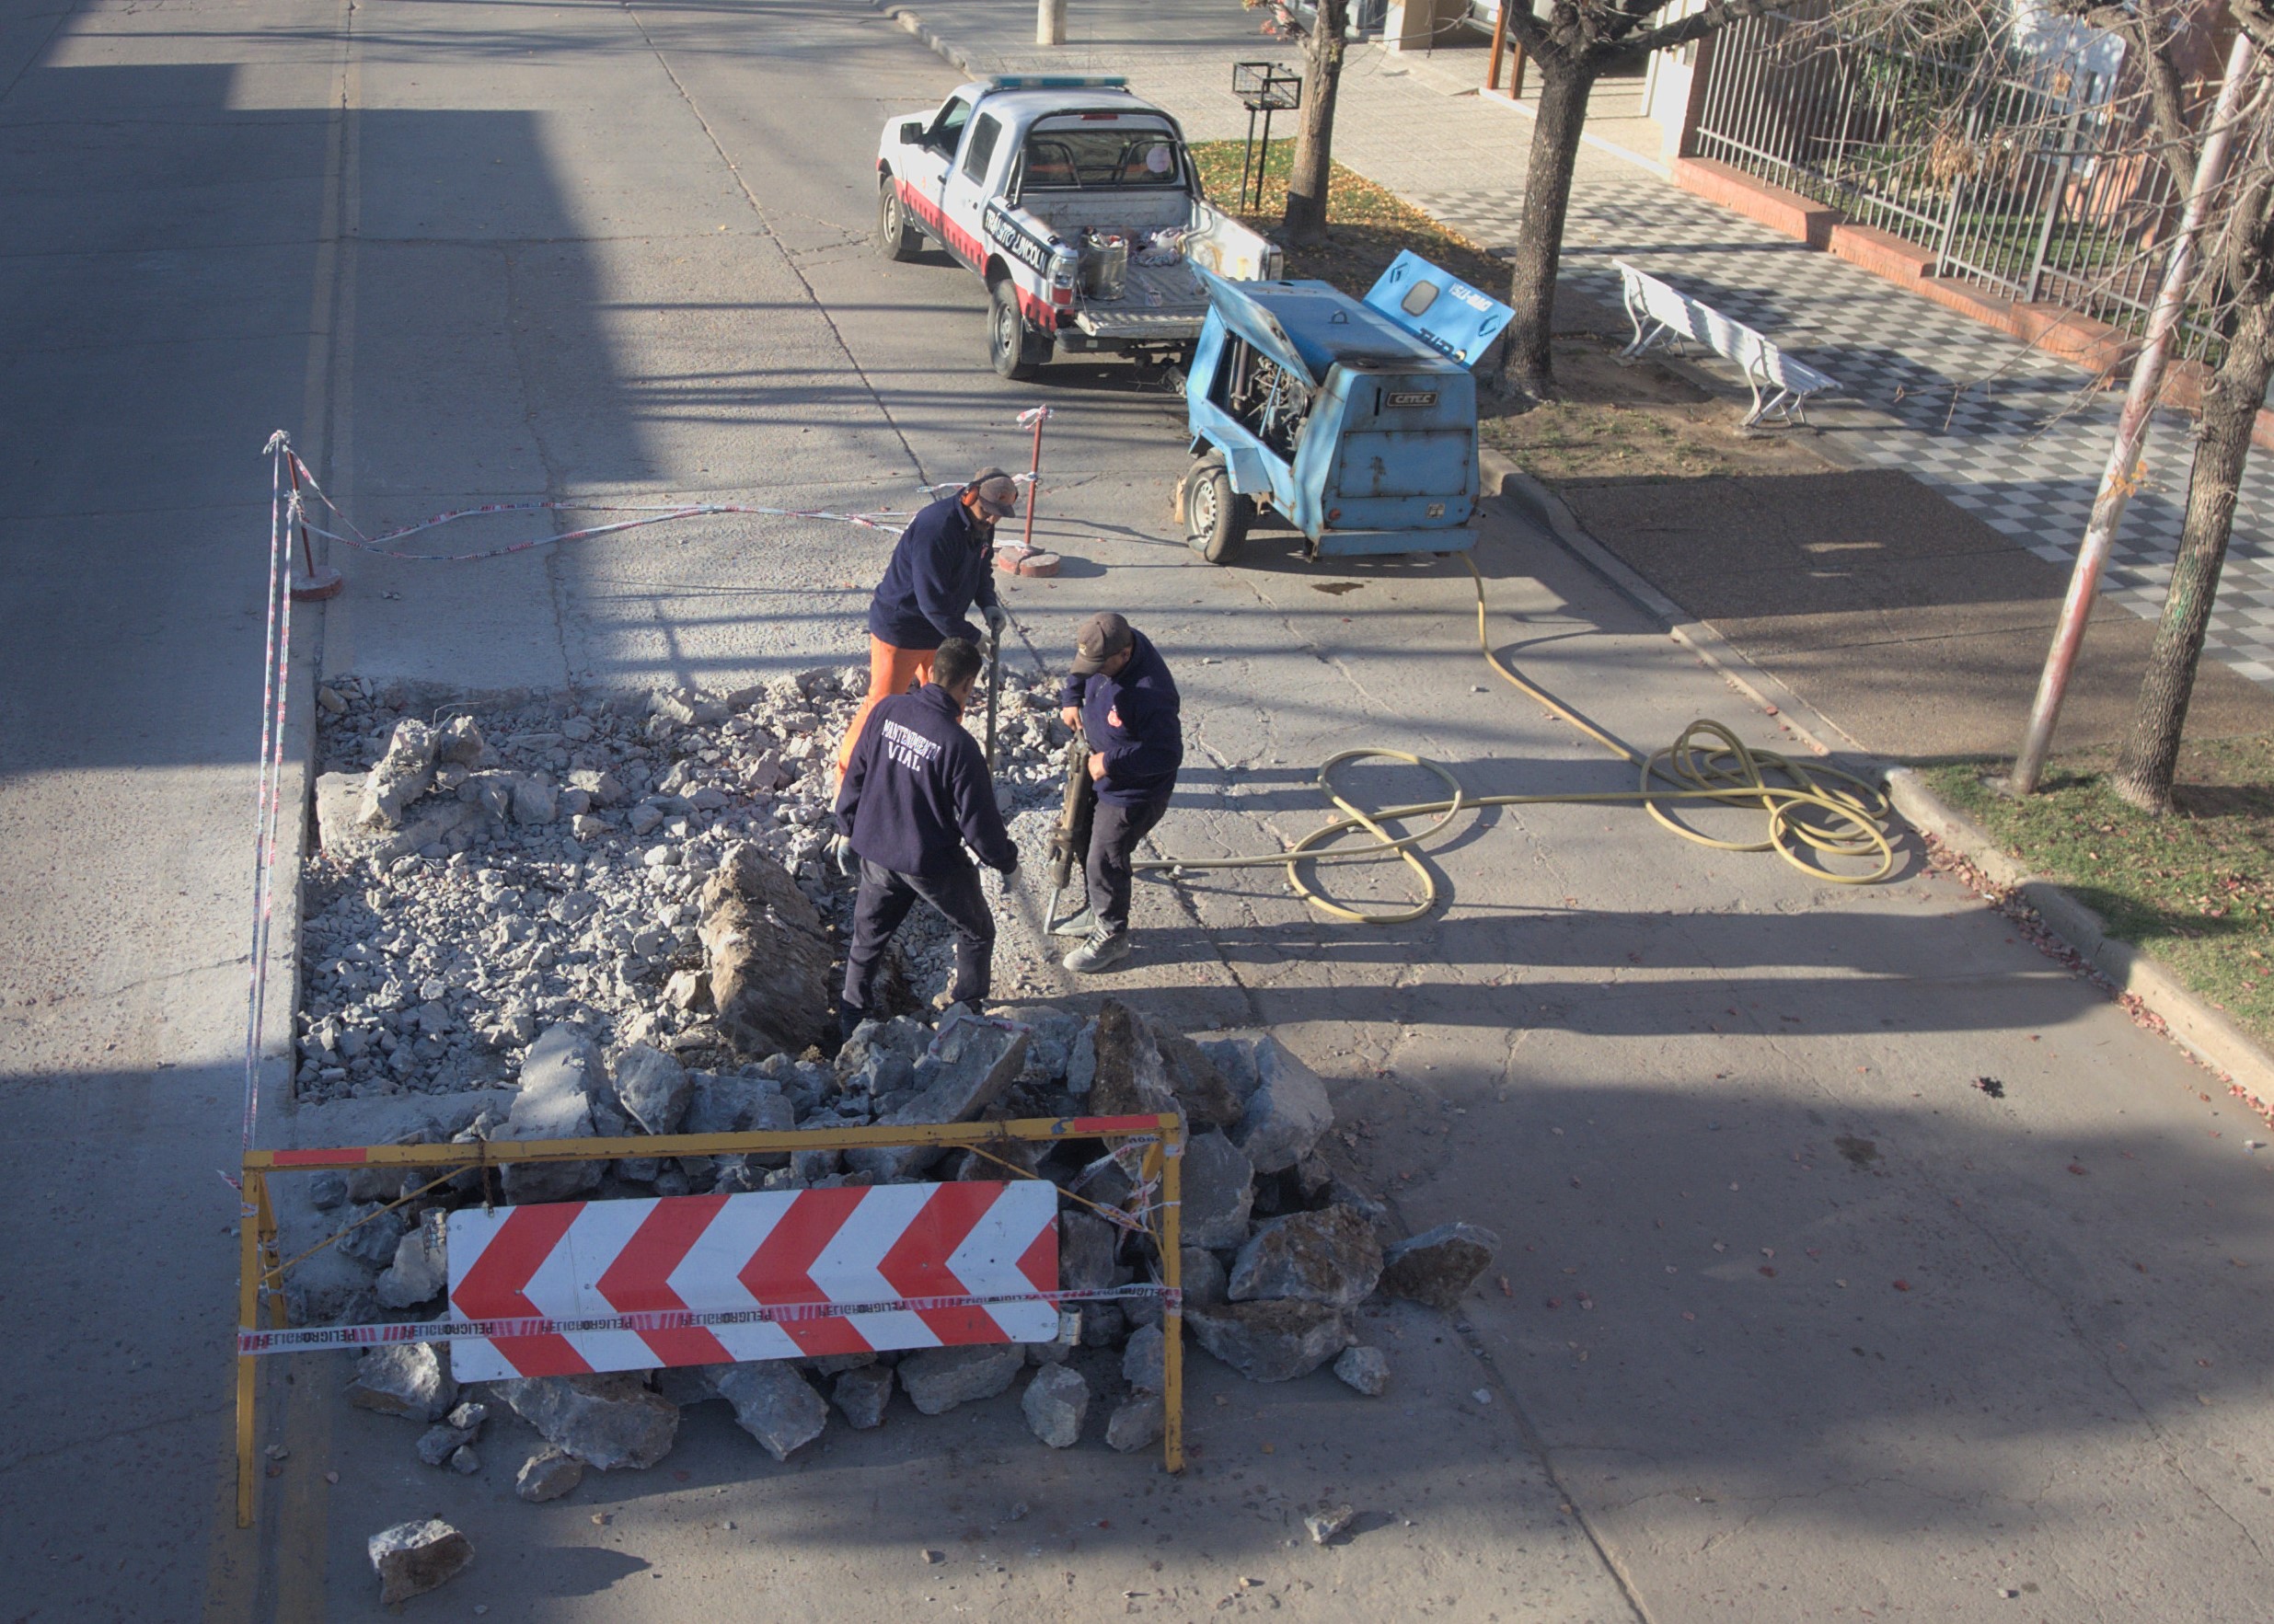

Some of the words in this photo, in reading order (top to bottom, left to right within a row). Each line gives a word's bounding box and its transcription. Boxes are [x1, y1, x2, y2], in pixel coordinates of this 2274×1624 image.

[1011, 234, 1047, 273] LINCOLN
[1395, 395, 1431, 404] CETEC
[887, 741, 921, 772] VIAL
